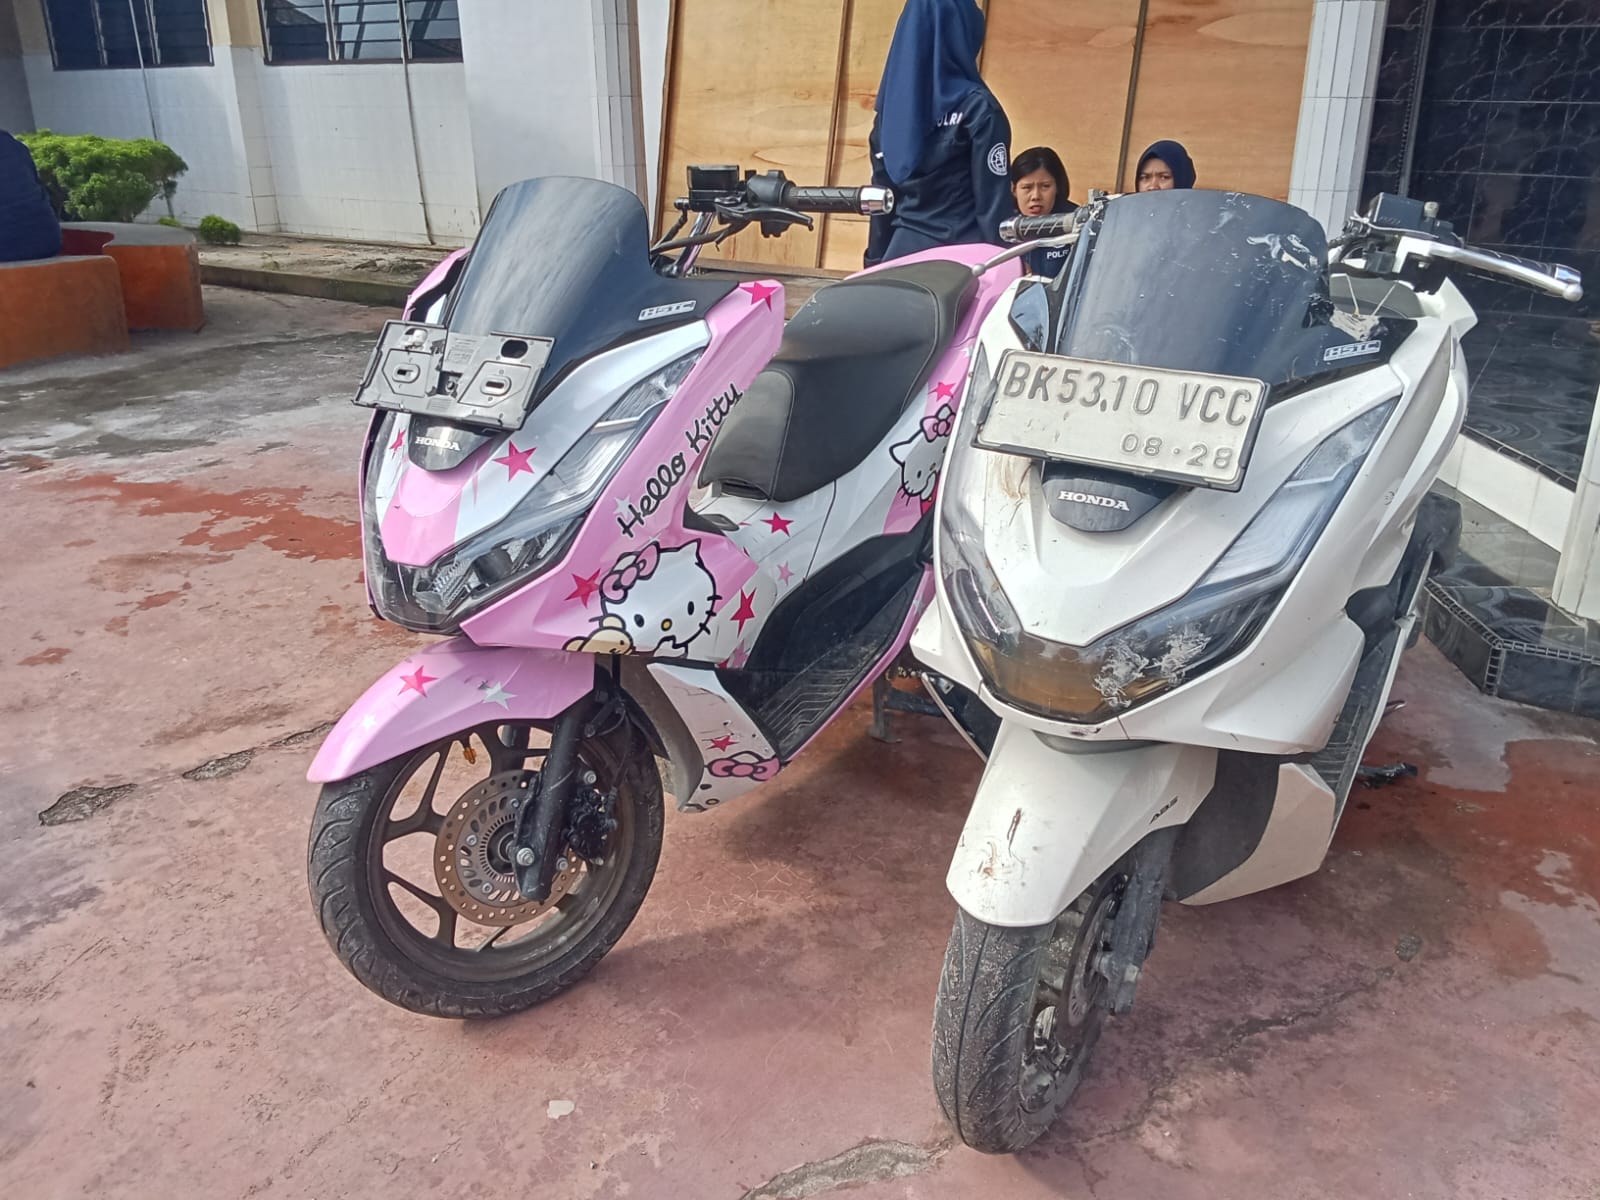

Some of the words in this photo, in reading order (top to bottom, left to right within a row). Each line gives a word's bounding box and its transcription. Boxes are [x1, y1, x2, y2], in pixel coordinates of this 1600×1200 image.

[1178, 382, 1252, 426] VCC
[415, 436, 460, 451] HONDA
[617, 452, 686, 538] Hello
[1058, 490, 1130, 512] HONDA
